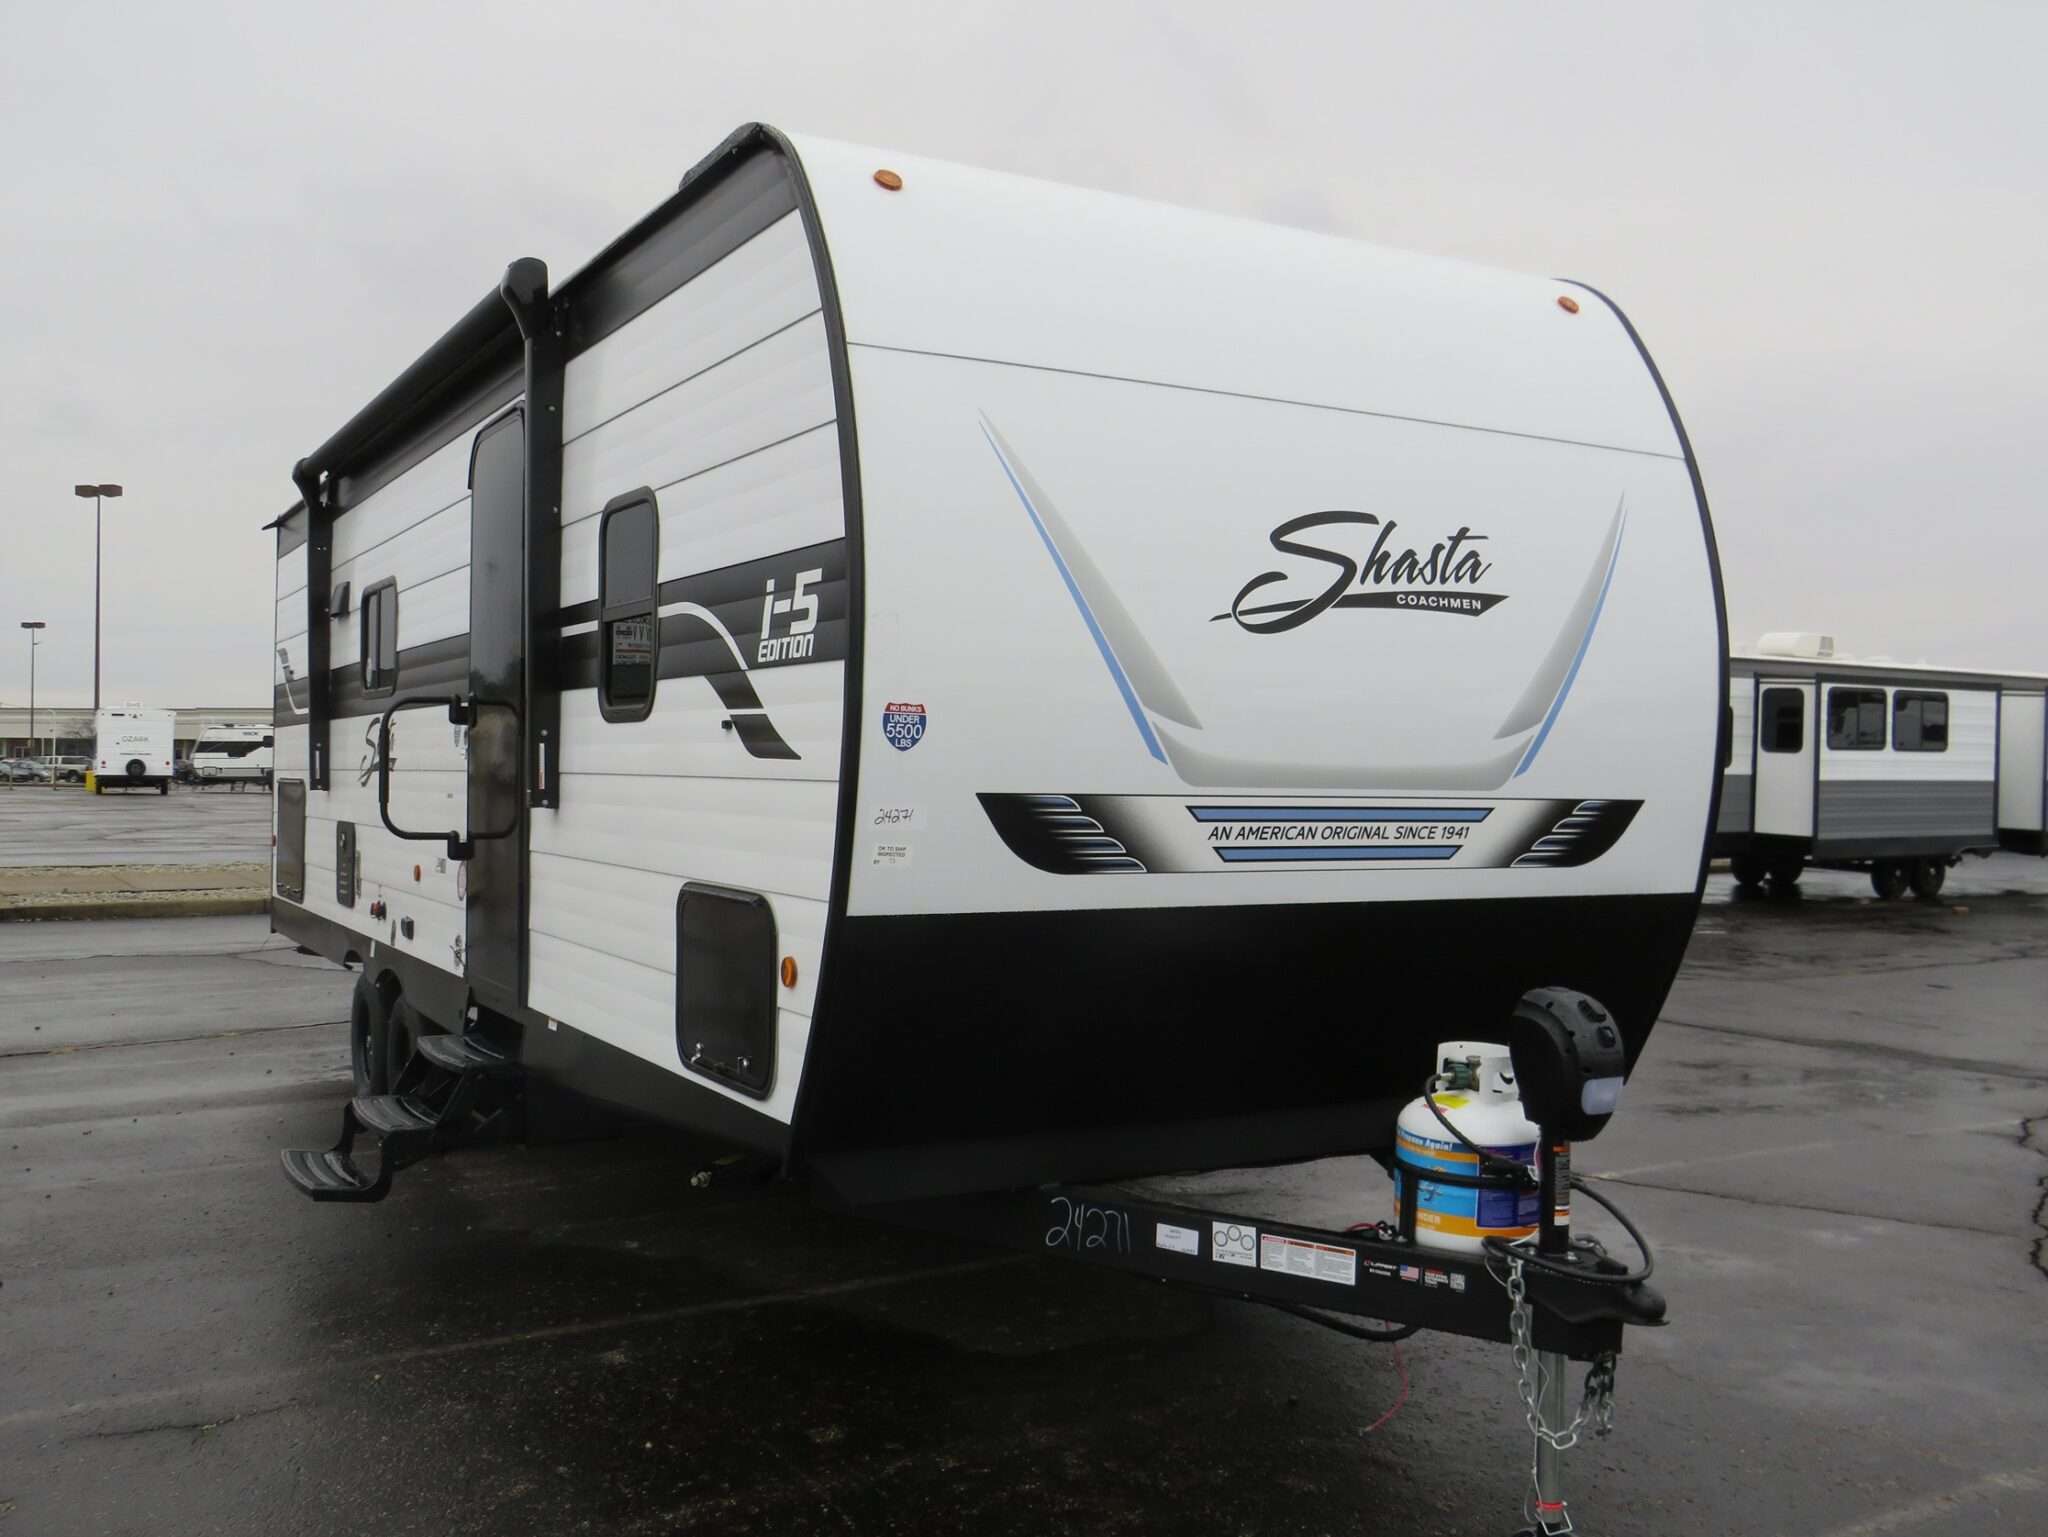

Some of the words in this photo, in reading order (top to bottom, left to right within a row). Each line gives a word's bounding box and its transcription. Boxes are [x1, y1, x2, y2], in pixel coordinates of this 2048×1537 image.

[1232, 510, 1492, 634] Shasta
[1396, 593, 1482, 610] COACHMEN
[758, 633, 815, 662] EDITION
[889, 704, 900, 712] NO
[901, 704, 922, 713] BUNKS
[889, 714, 920, 724] UNDER
[886, 723, 922, 739] 5500
[895, 738, 912, 748] LBS
[1208, 826, 1232, 841] AN
[1234, 826, 1317, 841] AMERICAN
[1321, 826, 1390, 840] ORIGINAL
[1394, 826, 1438, 840] SINCE
[1441, 826, 1470, 840] 1941
[1045, 1197, 1131, 1254] 24271
